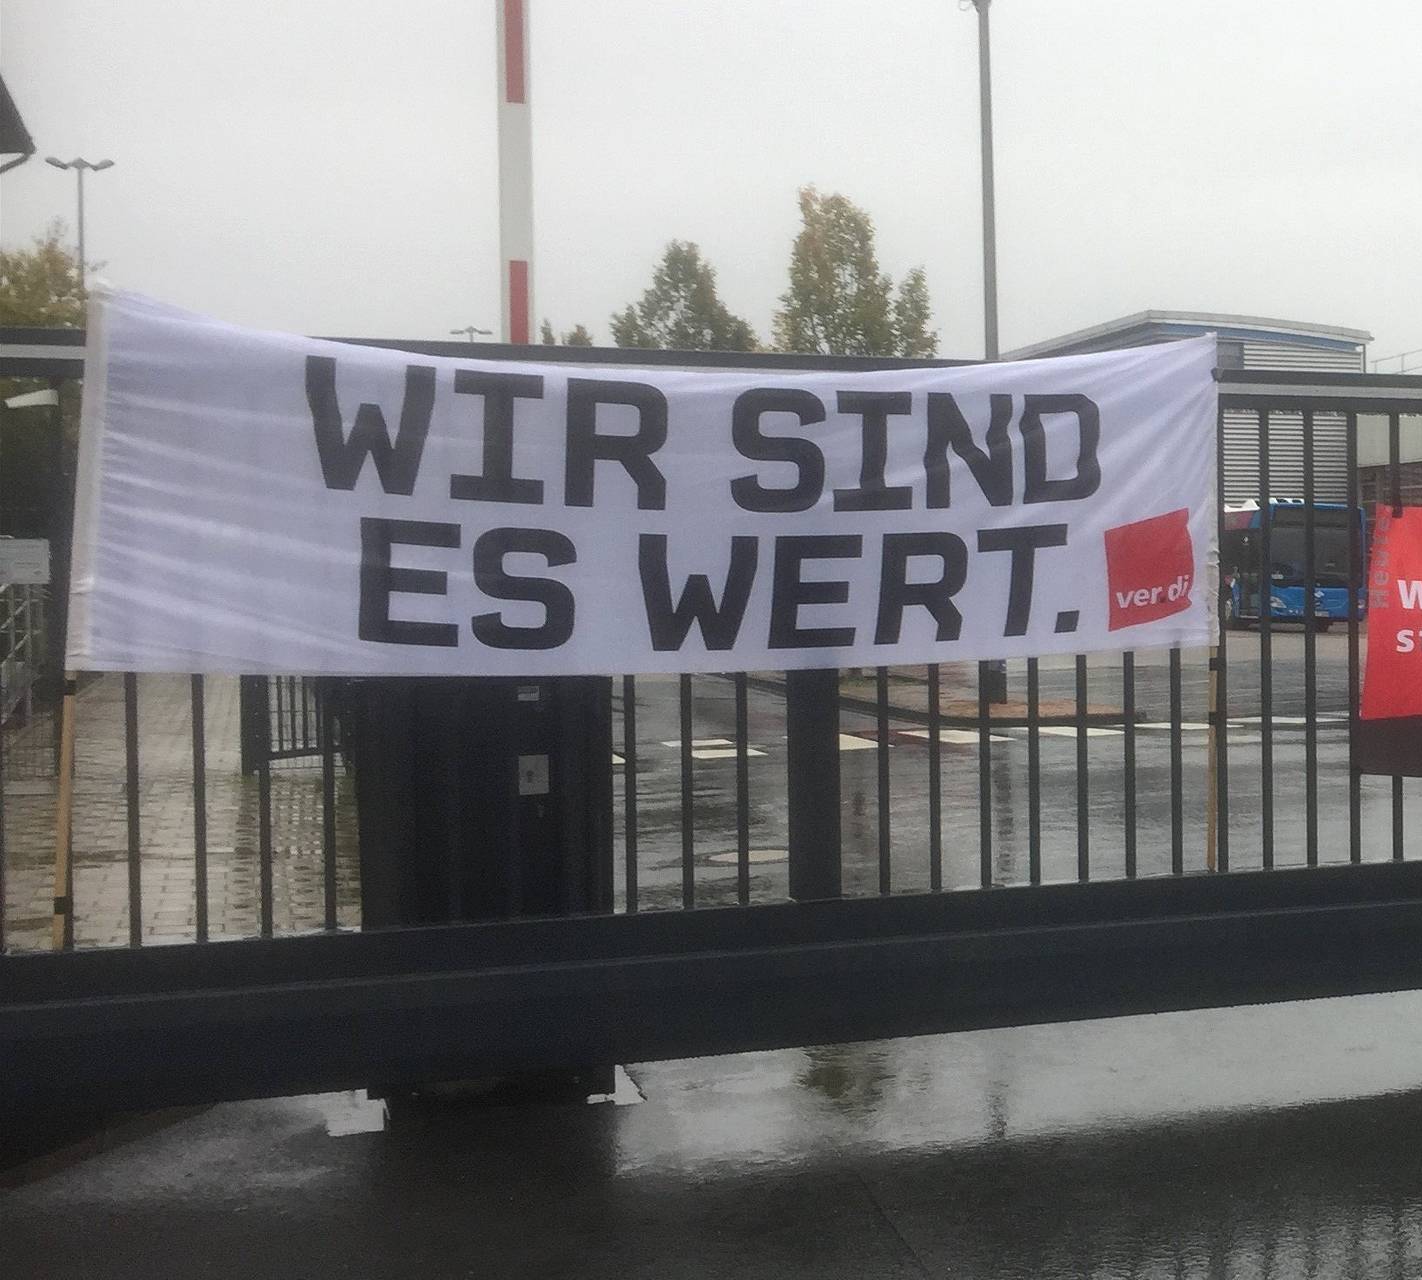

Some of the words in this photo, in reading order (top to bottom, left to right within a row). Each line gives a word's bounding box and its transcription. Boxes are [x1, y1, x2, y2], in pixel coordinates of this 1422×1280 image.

[305, 355, 668, 510] WIR
[730, 387, 1102, 512] SIND
[358, 517, 577, 650] ES
[638, 523, 1080, 651] WERT.
